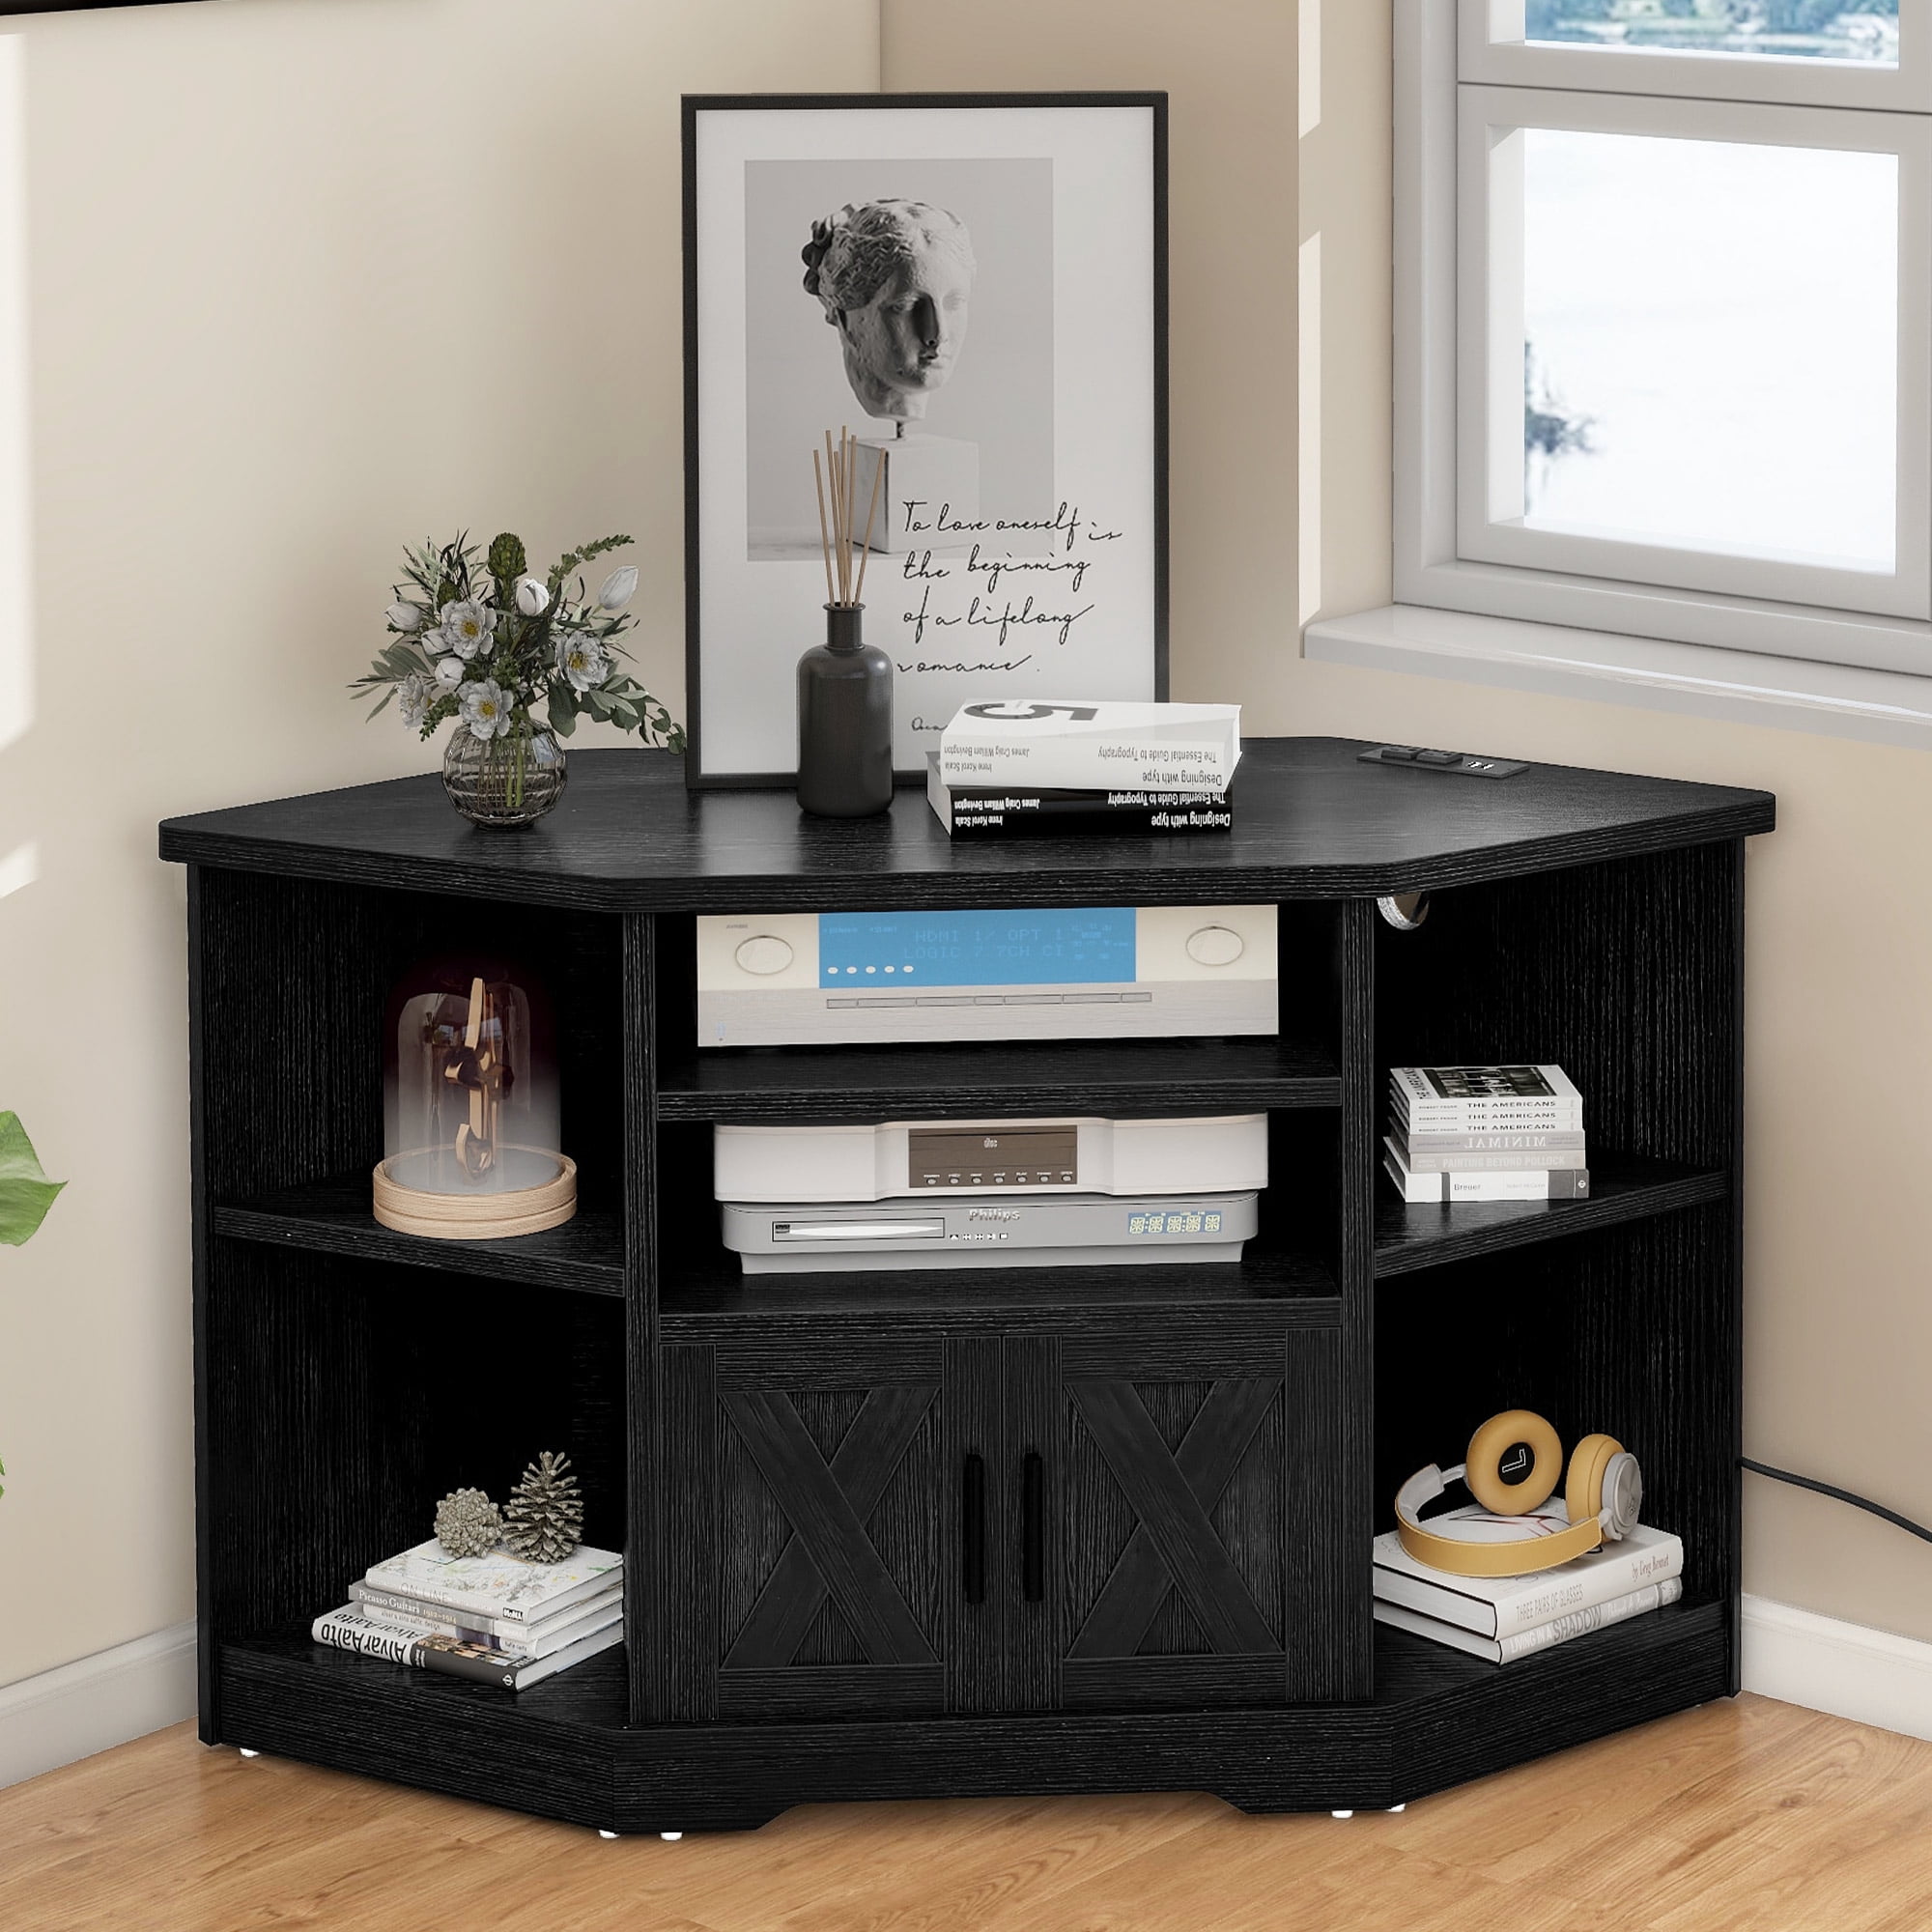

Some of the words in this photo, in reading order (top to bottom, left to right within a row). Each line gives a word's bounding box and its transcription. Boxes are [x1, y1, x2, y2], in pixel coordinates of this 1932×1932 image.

[902, 500, 931, 532] To
[937, 502, 990, 531] love
[996, 501, 1081, 552] oneself
[1088, 522, 1122, 540] is
[903, 550, 951, 580] the
[967, 544, 1091, 593] beginning
[903, 585, 929, 644] of
[935, 615, 962, 627] a
[968, 595, 1094, 646] lifelong
[995, 746, 1011, 757] Craig
[1011, 749, 1030, 758] James
[1098, 747, 1139, 761] Typography
[1141, 751, 1148, 760] to
[1149, 750, 1169, 762] Guide
[1171, 751, 1203, 763] Essential
[1204, 752, 1216, 763] The
[1142, 769, 1160, 783] type
[1162, 772, 1179, 785] with
[1181, 770, 1222, 786] Designing
[1006, 797, 1021, 810] Craig
[1021, 798, 1040, 810] James
[1107, 792, 1149, 807] Typography
[1149, 793, 1157, 805] to
[1158, 793, 1179, 806] Guide
[1179, 792, 1211, 806] Essential
[1211, 792, 1226, 804] The
[1151, 811, 1170, 828] type
[1171, 814, 1188, 828] with
[1190, 810, 1231, 827] Designing
[914, 928, 960, 944] HDMI
[1008, 927, 1042, 942] OPT
[903, 946, 962, 959] LOGIC
[1442, 1157, 1485, 1169] PAINTING
[1486, 1156, 1522, 1168] BEYOND
[1524, 1155, 1566, 1167] POLLOCK
[1454, 1183, 1482, 1192] Breuer
[358, 1589, 388, 1607] Picasso
[388, 1595, 421, 1614] Guitars
[332, 1612, 379, 1630] Aalto
[1551, 1605, 1603, 1641] SHADOW
[320, 1623, 365, 1650] Aalto
[377, 1624, 424, 1640] Alvar
[363, 1635, 408, 1663] Alvar
